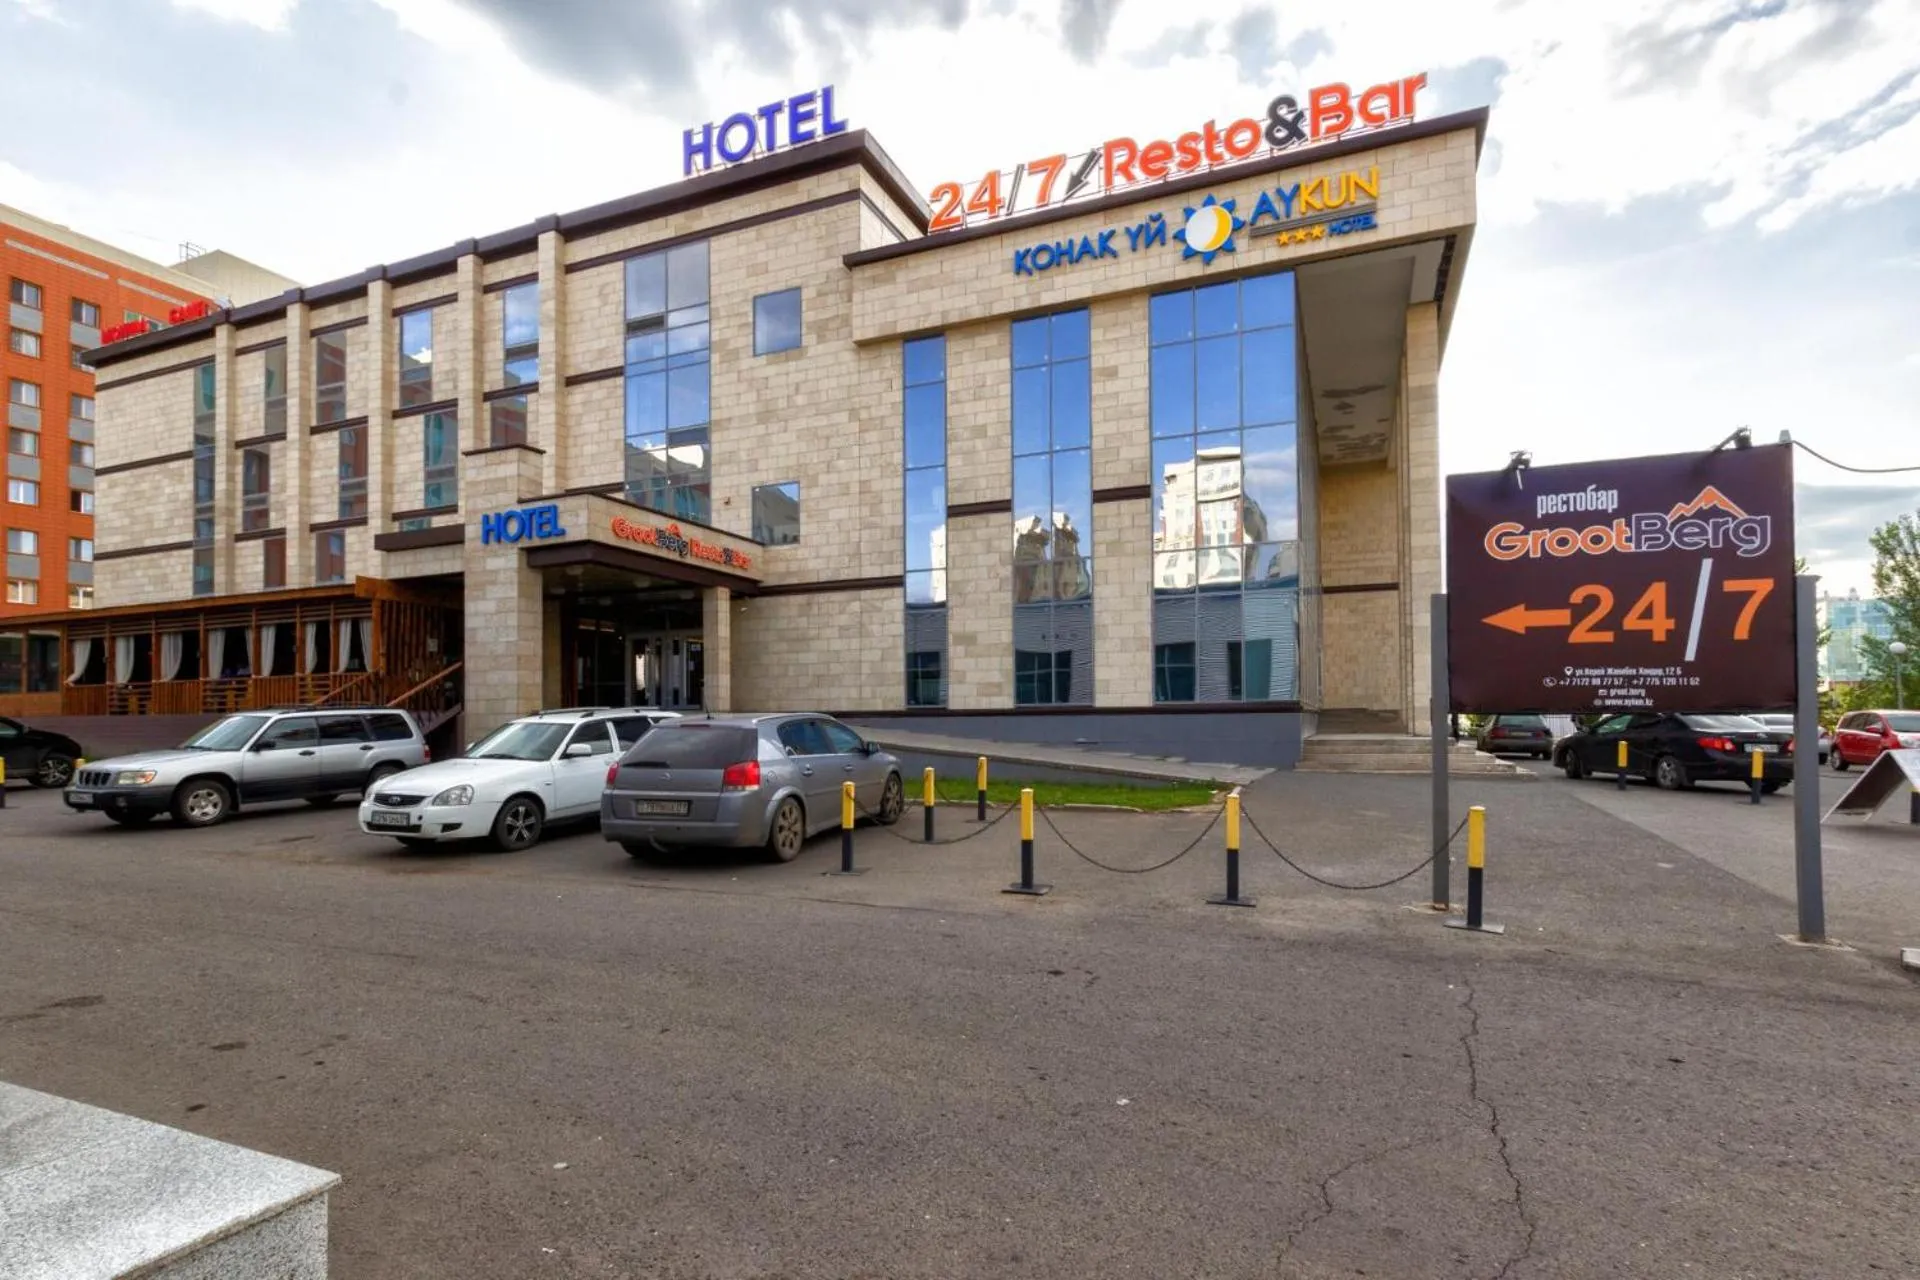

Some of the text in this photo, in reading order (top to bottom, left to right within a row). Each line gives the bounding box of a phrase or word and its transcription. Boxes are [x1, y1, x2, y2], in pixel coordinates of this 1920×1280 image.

[683, 85, 849, 176] HOTEL
[928, 72, 1428, 232] 24/7 Resto&Bar
[1250, 165, 1380, 226] AYKUN
[1328, 213, 1377, 237] HOTEL
[481, 503, 567, 544] HOTEL
[1537, 484, 1618, 518] рестобар
[1485, 512, 1771, 560] GrootBerg
[1568, 558, 1775, 662] 24/7
